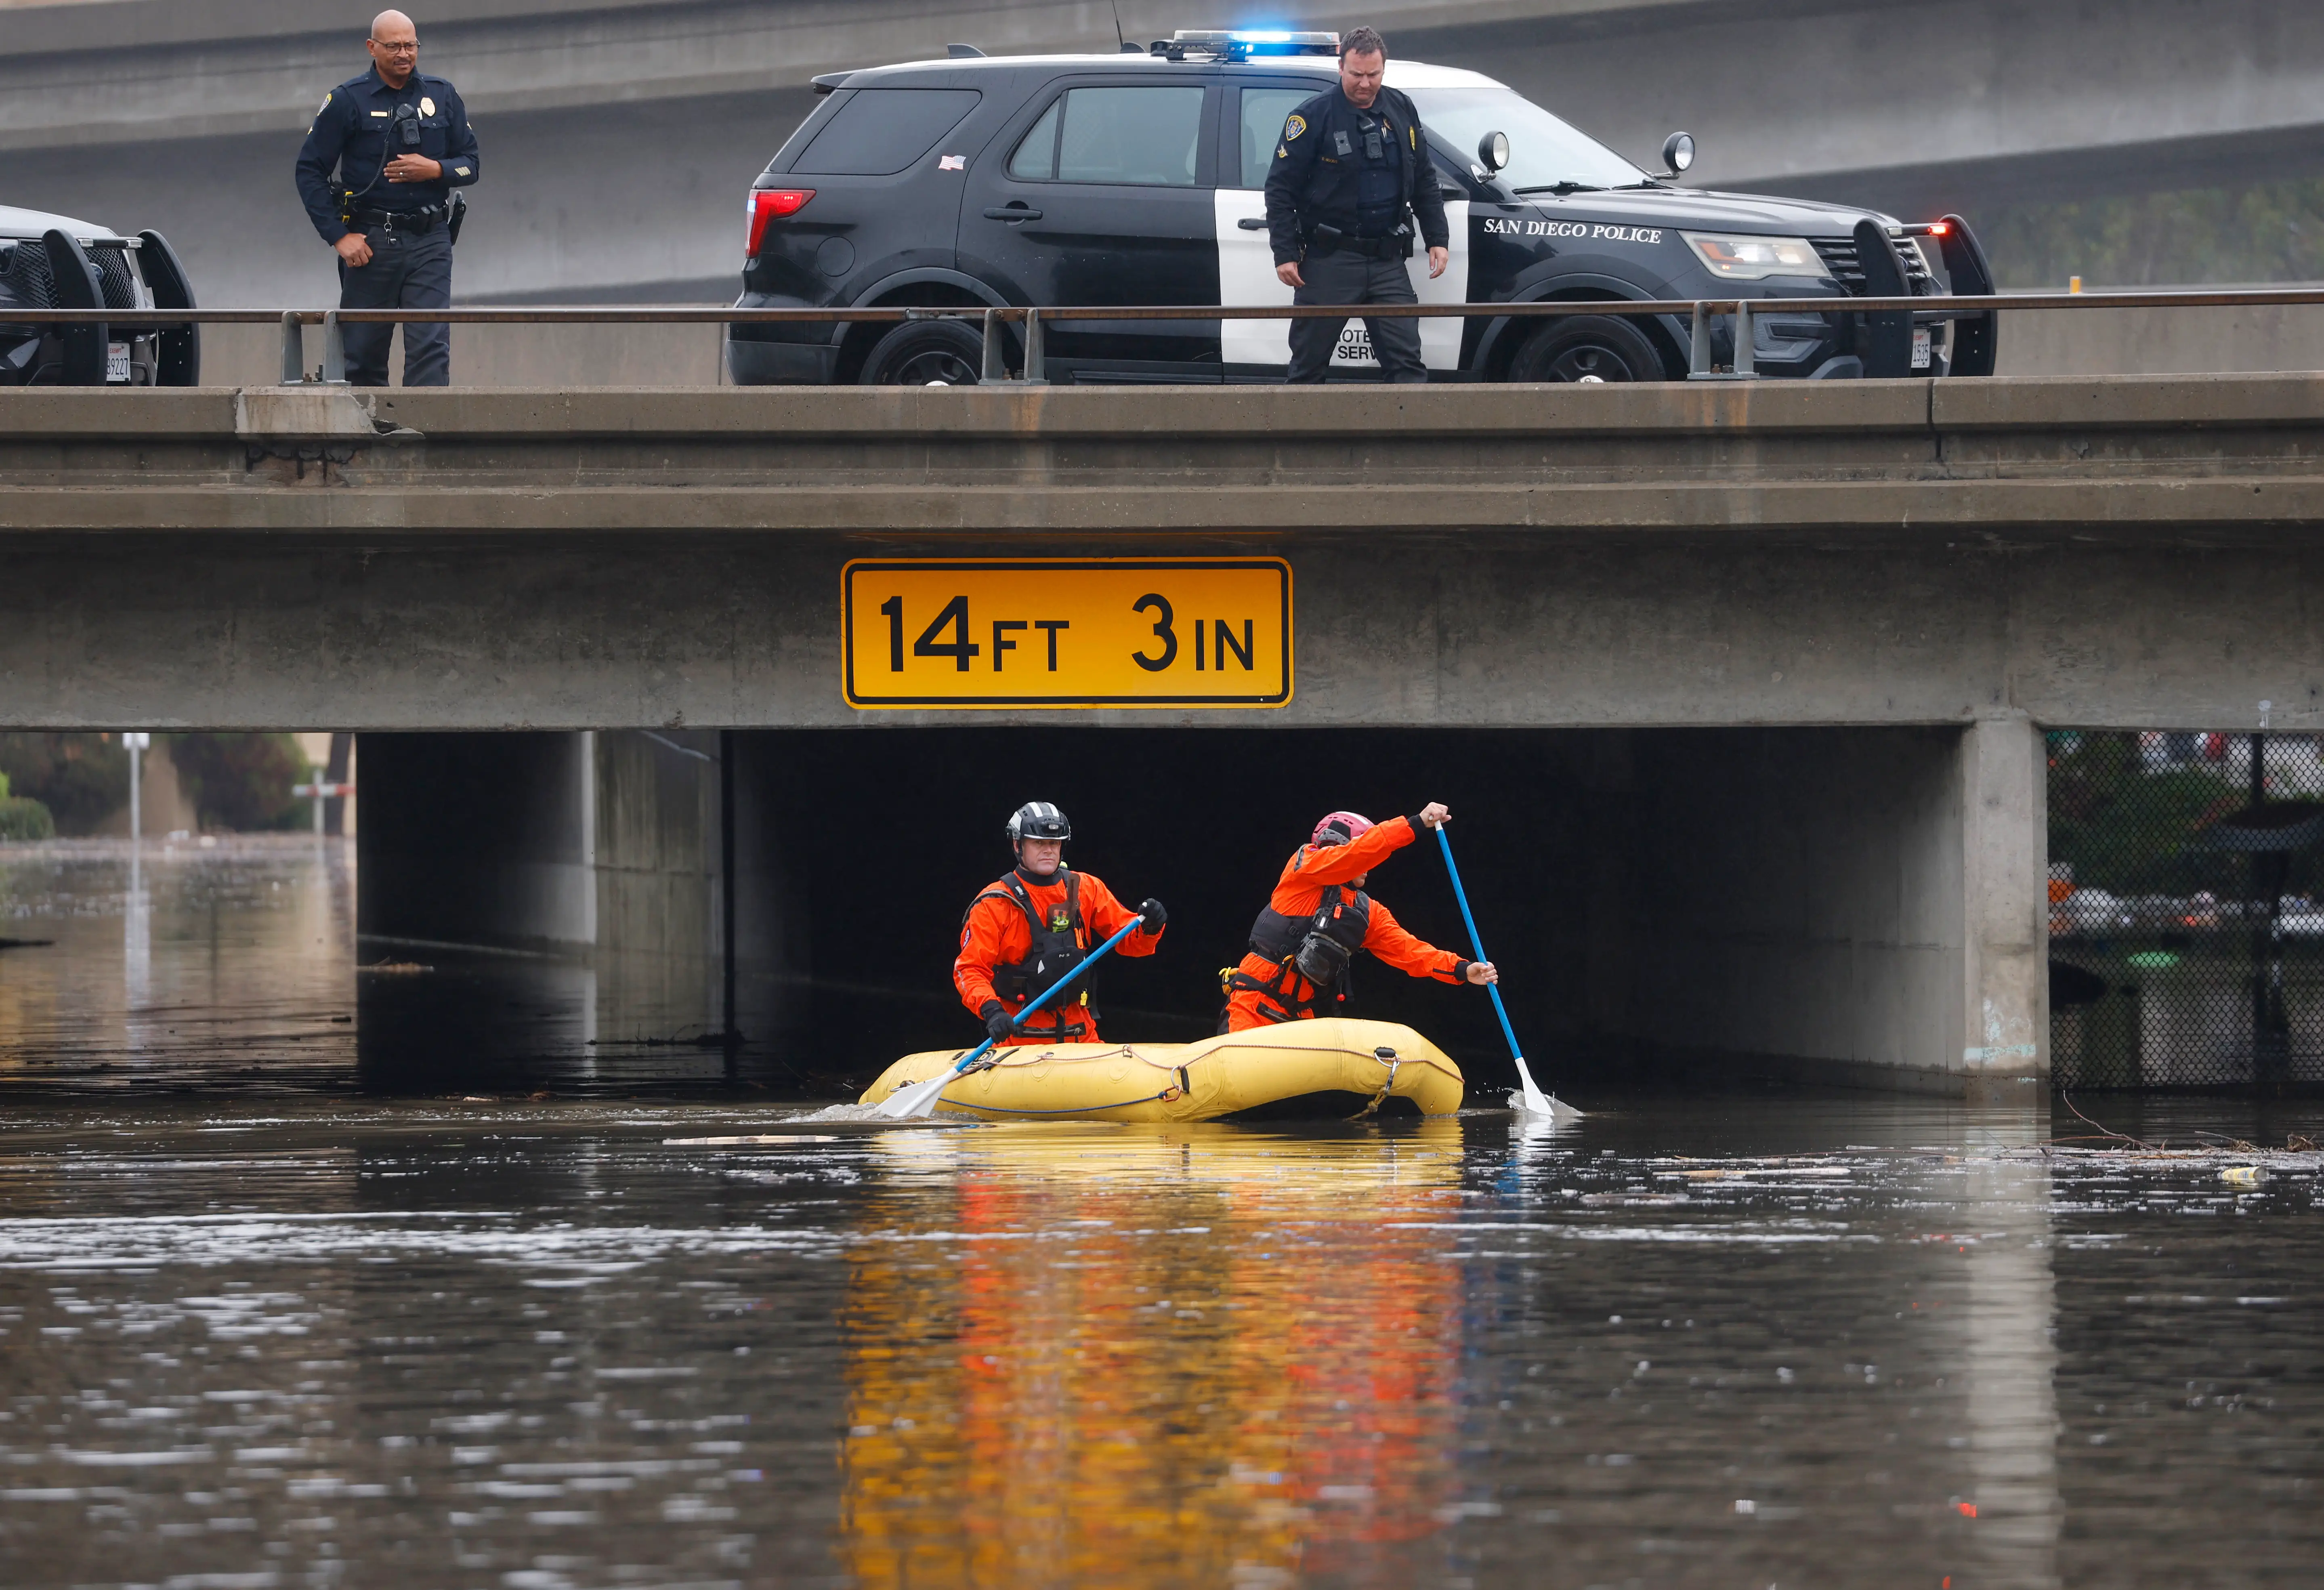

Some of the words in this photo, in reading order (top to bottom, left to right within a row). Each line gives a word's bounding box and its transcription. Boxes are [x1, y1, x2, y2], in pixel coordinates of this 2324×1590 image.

[1484, 218, 1522, 234] SAN
[1526, 221, 1587, 237] DIEGO
[1591, 225, 1662, 244] POLICE
[1338, 329, 1371, 342] OTE
[1913, 344, 1928, 361] 1535
